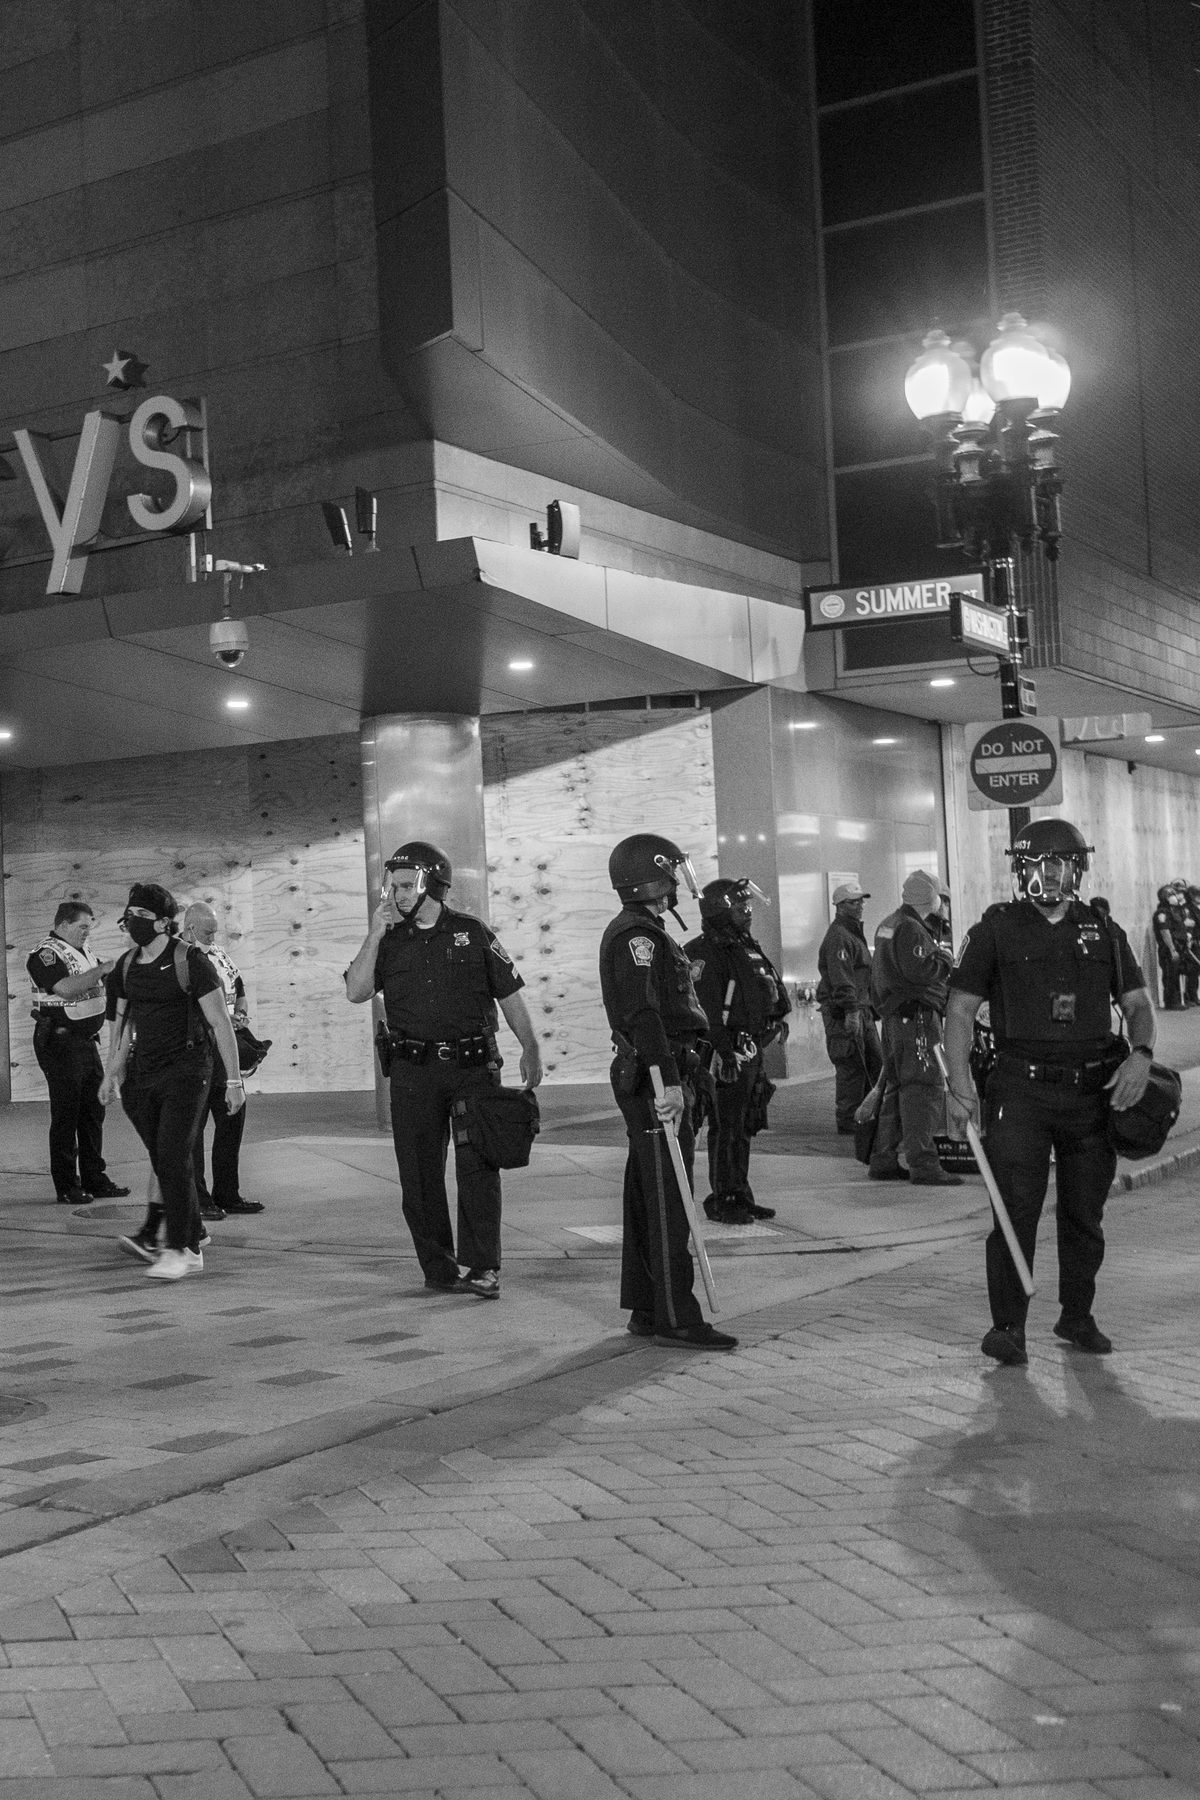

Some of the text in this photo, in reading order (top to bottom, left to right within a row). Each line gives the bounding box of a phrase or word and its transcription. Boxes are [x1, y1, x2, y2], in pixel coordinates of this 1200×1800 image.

[855, 581, 952, 615] SUMMER
[981, 739, 1044, 756] DO NOT
[989, 773, 1040, 788] ENTER
